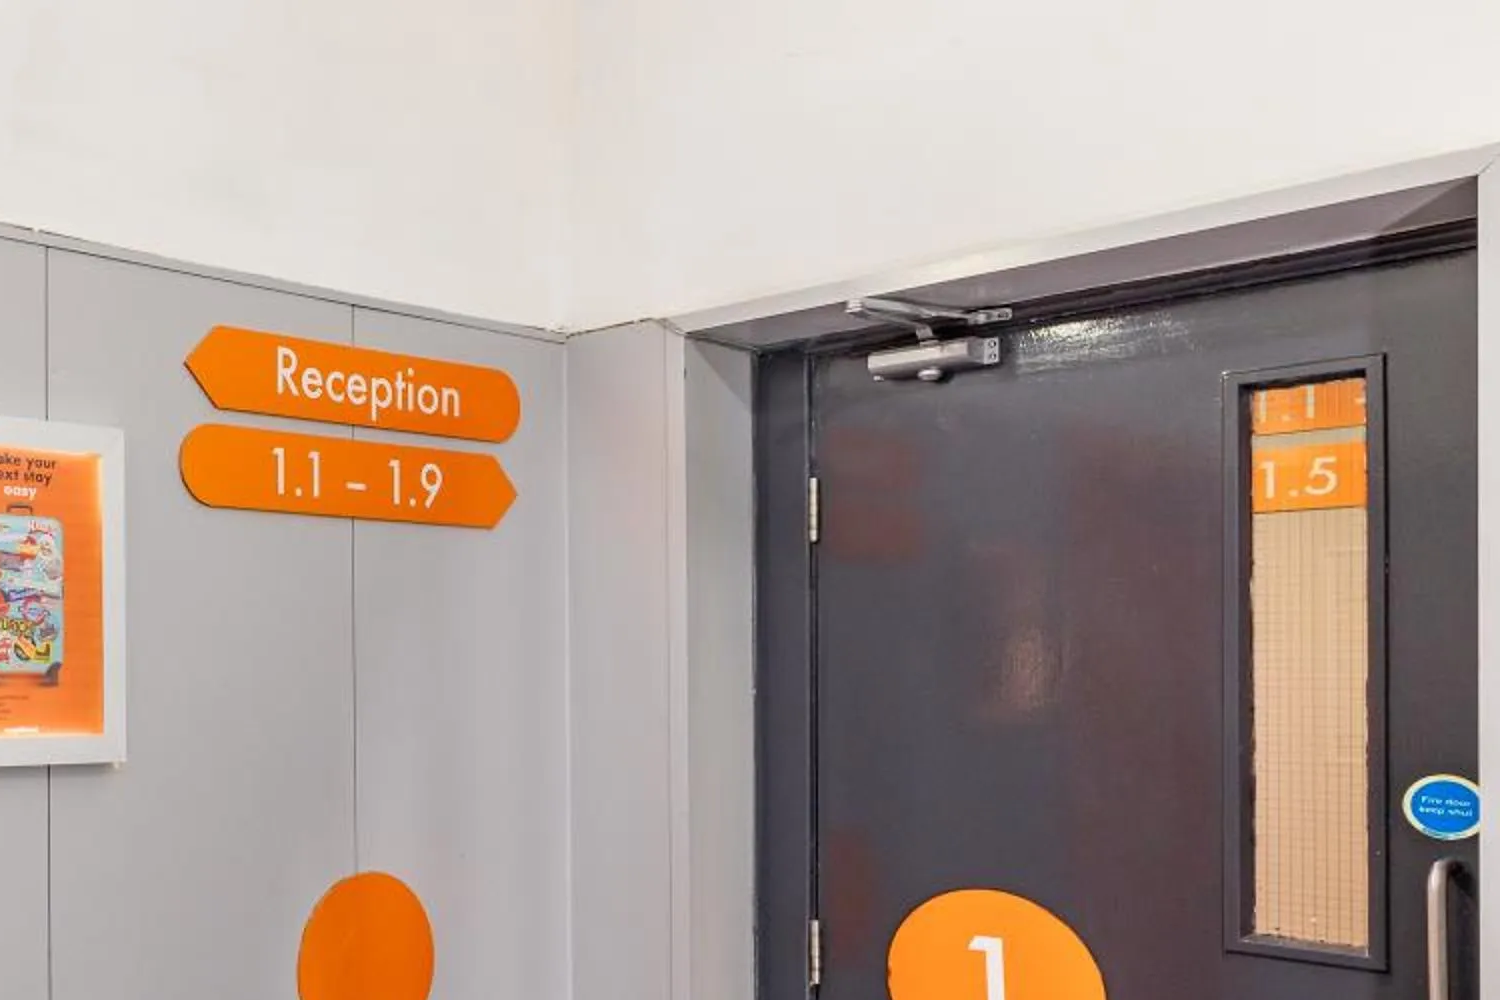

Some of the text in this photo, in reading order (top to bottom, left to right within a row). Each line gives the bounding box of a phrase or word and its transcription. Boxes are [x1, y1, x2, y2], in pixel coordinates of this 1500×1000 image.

[277, 346, 461, 420] Reception
[24, 471, 52, 488] stay
[26, 458, 56, 471] your
[272, 447, 321, 497] 1.1
[388, 459, 443, 508] 1.9
[1259, 456, 1338, 499] 1.5
[3, 485, 36, 501] easy
